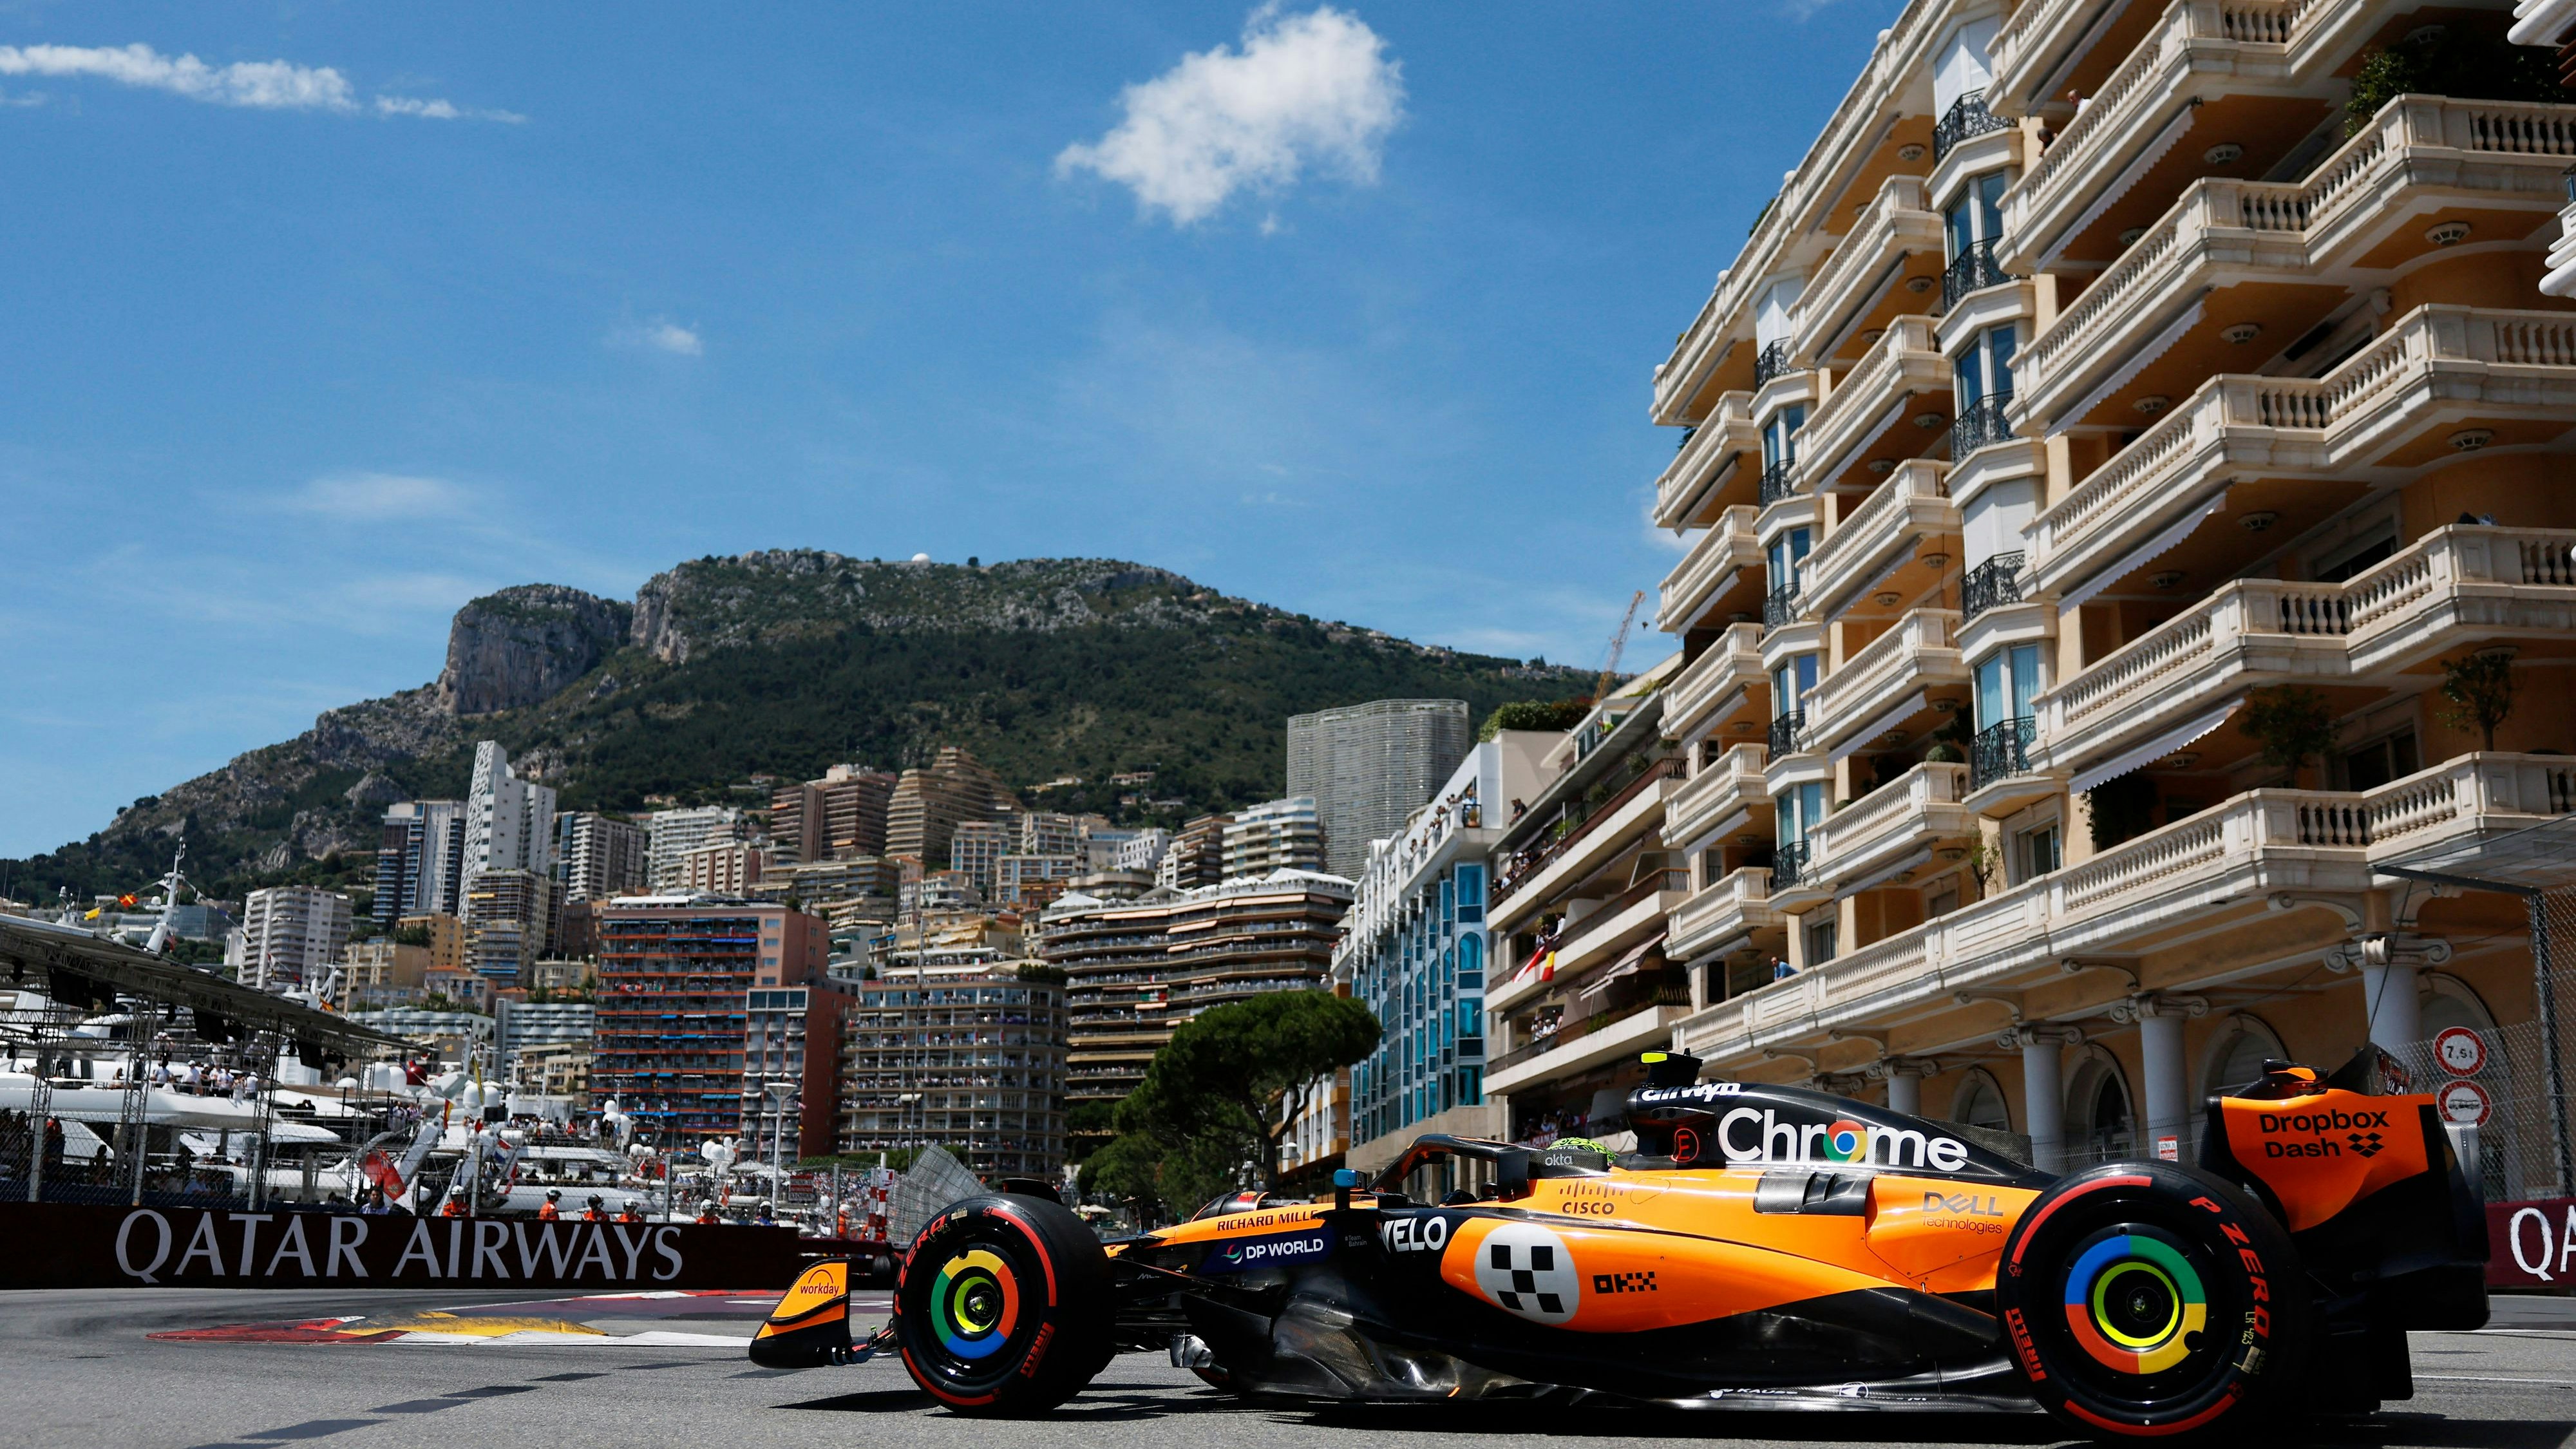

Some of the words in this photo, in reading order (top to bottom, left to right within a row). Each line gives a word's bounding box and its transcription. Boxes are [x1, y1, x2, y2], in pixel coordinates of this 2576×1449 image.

[1642, 1083, 1741, 1102] allwyn
[2259, 1109, 2391, 1135] Dropbox
[1718, 1107, 1968, 1171] Chrome
[2264, 1137, 2341, 1158] Dash
[1545, 1154, 1573, 1166] okta
[1562, 1202, 1615, 1215] CISCO
[1922, 1191, 2003, 1217] DELL
[1217, 1215, 1273, 1231] RICHARD
[1379, 1216, 1447, 1253] VELO
[1922, 1215, 2002, 1235] Technologies
[115, 1209, 370, 1284] QATAR
[392, 1218, 683, 1280] AIRWAYS
[898, 1215, 947, 1289] ZERO
[1246, 1245, 1266, 1259] DP
[1267, 1238, 1323, 1256] WORLD
[2189, 1197, 2222, 1213] P
[2219, 1222, 2270, 1339] ZERO
[800, 1282, 839, 1296] workday
[1593, 1271, 1658, 1294] OKX
[1019, 1321, 1055, 1378] PIRELLI
[2005, 1308, 2047, 1381] PIRELLI
